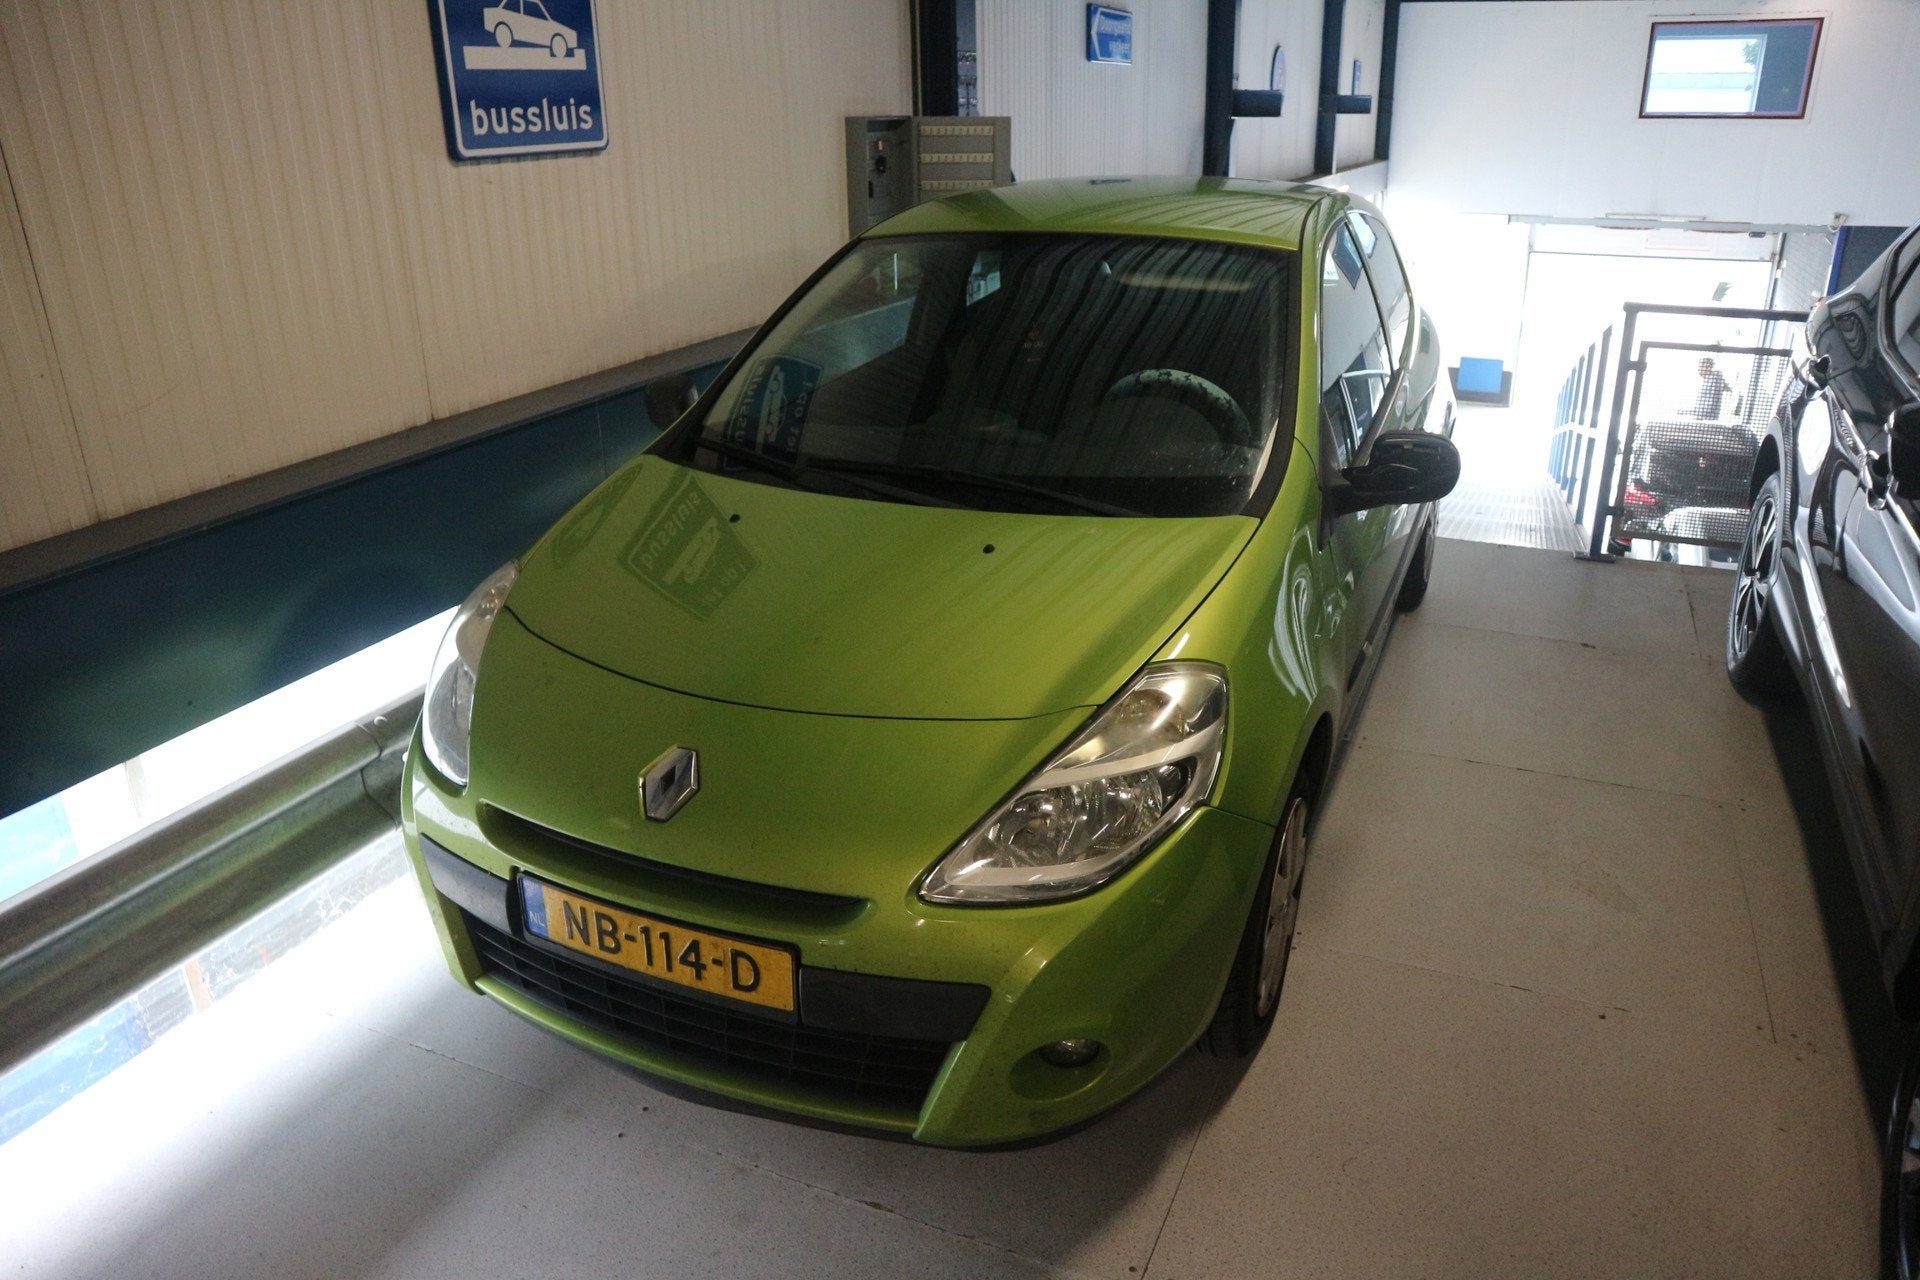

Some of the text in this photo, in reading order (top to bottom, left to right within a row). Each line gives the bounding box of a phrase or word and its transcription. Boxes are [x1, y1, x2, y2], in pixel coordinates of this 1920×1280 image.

[470, 97, 593, 135] bussluis
[529, 900, 761, 993] NL NB-114-D
